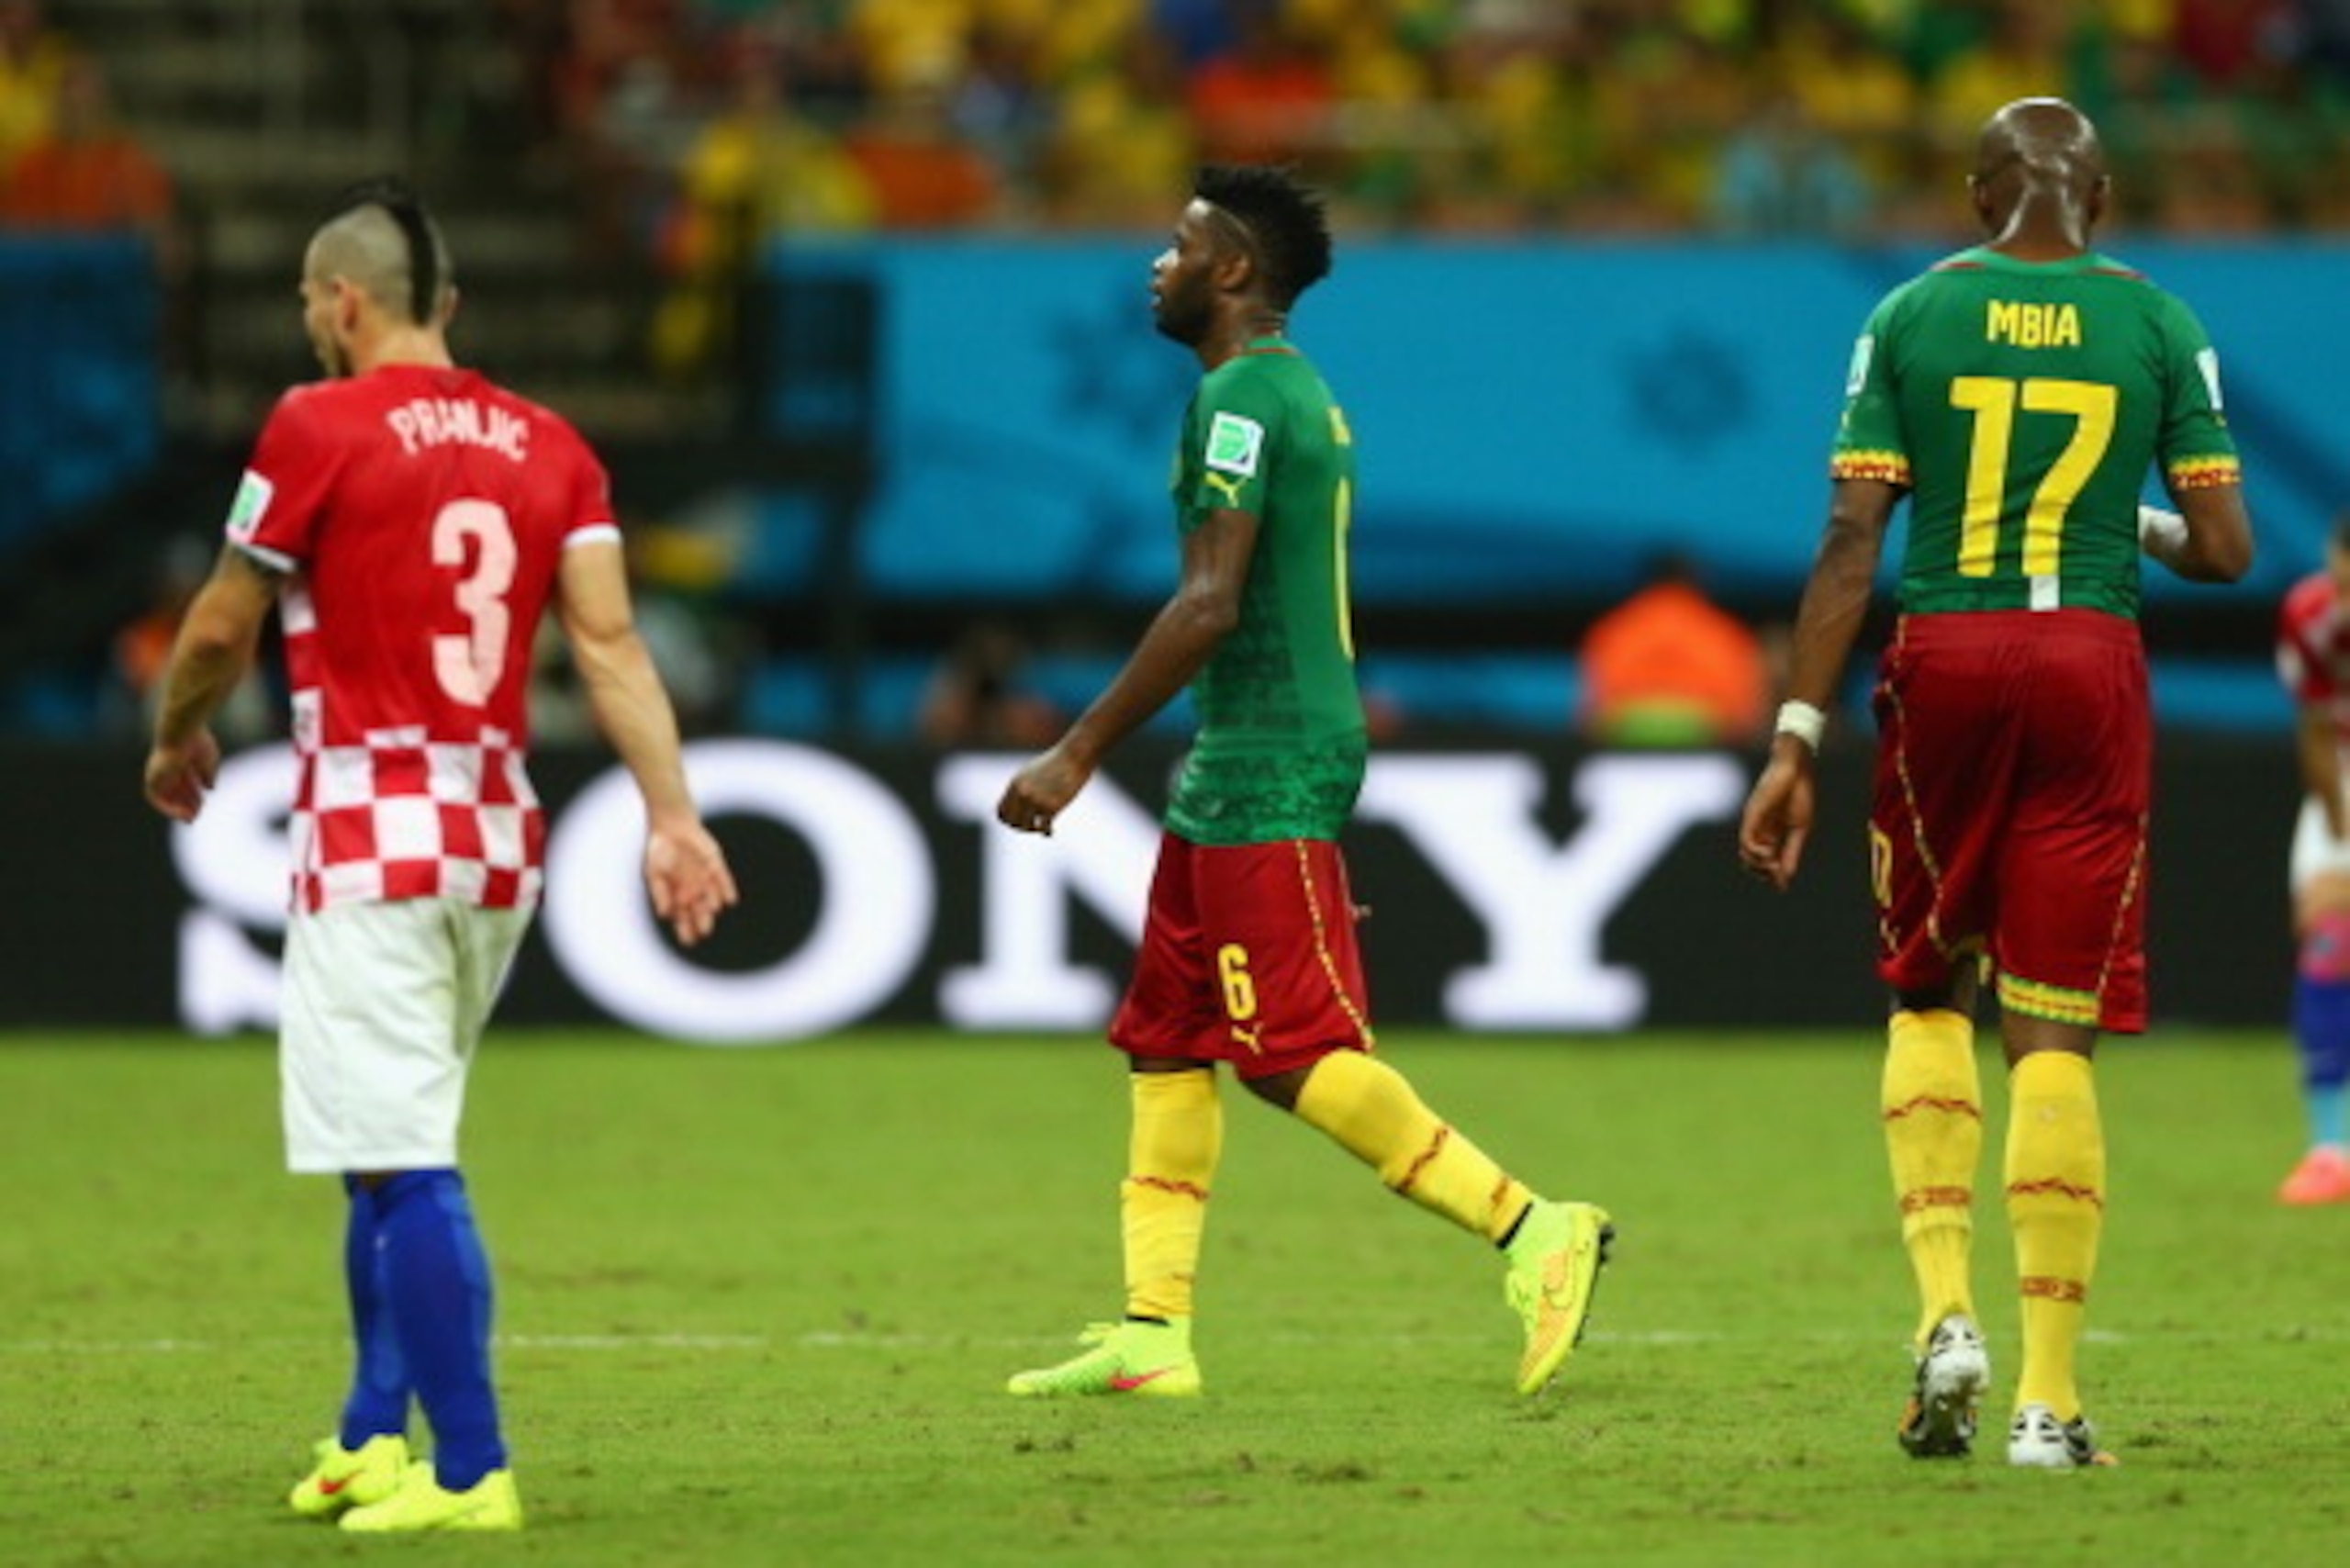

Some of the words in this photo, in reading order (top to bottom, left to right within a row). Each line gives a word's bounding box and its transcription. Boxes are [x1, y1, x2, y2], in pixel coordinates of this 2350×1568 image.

[1986, 299, 2081, 348] MBIA
[1949, 376, 2118, 577] 17
[431, 498, 517, 707] 3
[1217, 943, 1257, 1020] 6
